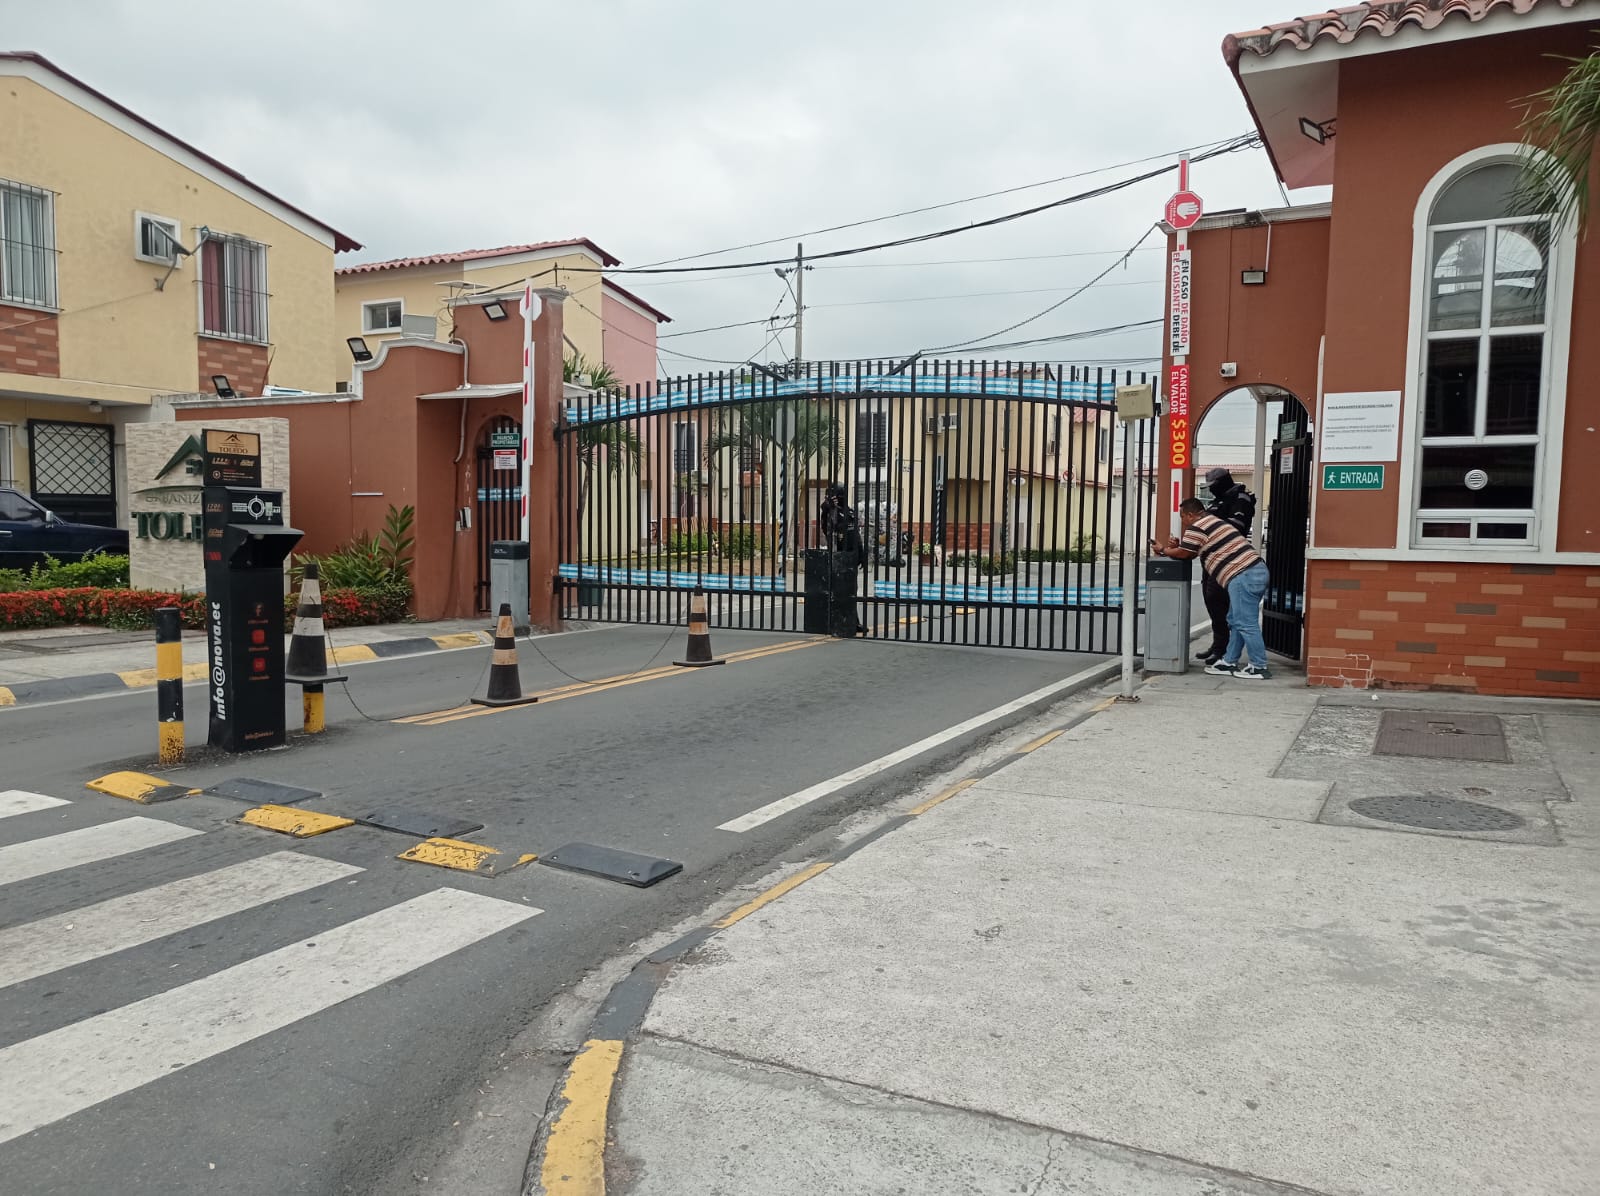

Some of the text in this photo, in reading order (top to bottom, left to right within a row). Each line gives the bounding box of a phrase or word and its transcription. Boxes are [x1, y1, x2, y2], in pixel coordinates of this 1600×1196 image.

[1173, 252, 1180, 263] EL
[1172, 265, 1180, 313] CAUSANTE
[1181, 260, 1190, 344] EN CASO DE DAÑO
[1172, 315, 1180, 339] DEBE
[1171, 371, 1179, 414] EL VALOR
[1179, 367, 1187, 416] CANCELAR
[218, 446, 248, 454] TOLEDO
[1171, 418, 1187, 465] $300
[1340, 471, 1379, 484] ENTRADA
[212, 601, 226, 721] info@nova.ec
